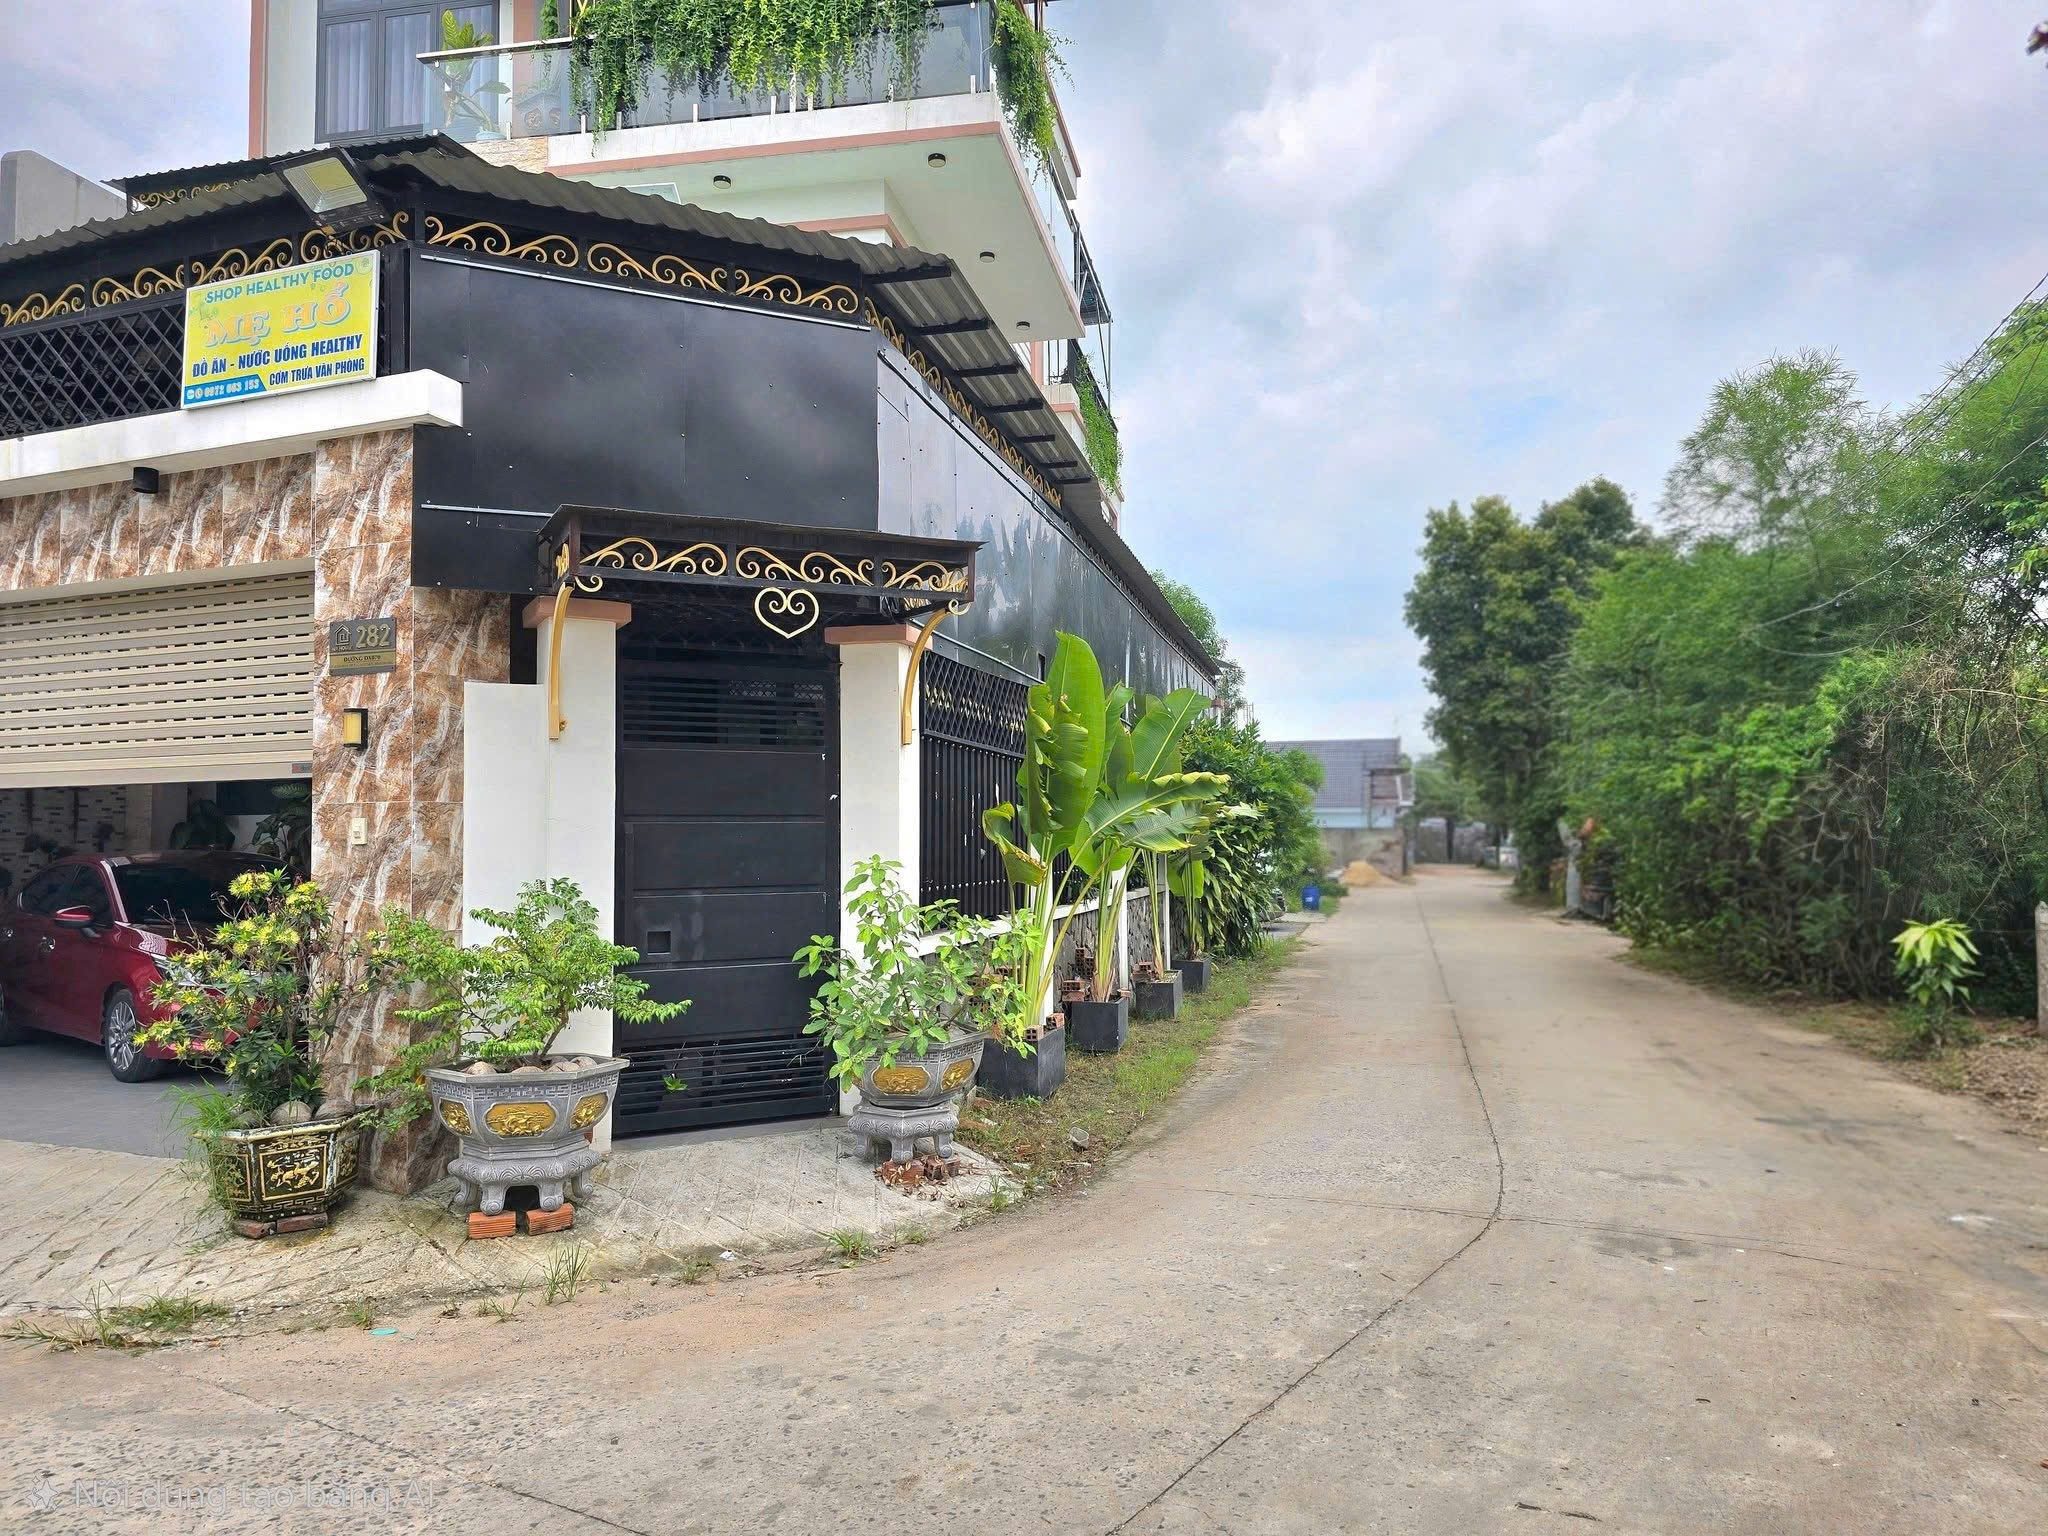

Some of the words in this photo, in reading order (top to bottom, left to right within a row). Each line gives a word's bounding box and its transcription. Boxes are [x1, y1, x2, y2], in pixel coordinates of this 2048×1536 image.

[206, 286, 242, 304] SHOP
[246, 272, 309, 295] HEALTHY
[313, 263, 354, 283] FOOD
[205, 310, 270, 347] MẸ
[192, 357, 207, 377] ĐỒ
[211, 358, 227, 376] ĂN
[238, 350, 271, 369] NƯỚC
[274, 342, 307, 362] UỐNG
[311, 334, 363, 356] HEALTHY
[269, 372, 289, 386] CƠM
[291, 366, 313, 382] TRƯA
[315, 362, 333, 378] VĂN
[335, 357, 365, 374] PHÒNG
[356, 623, 390, 648] 282
